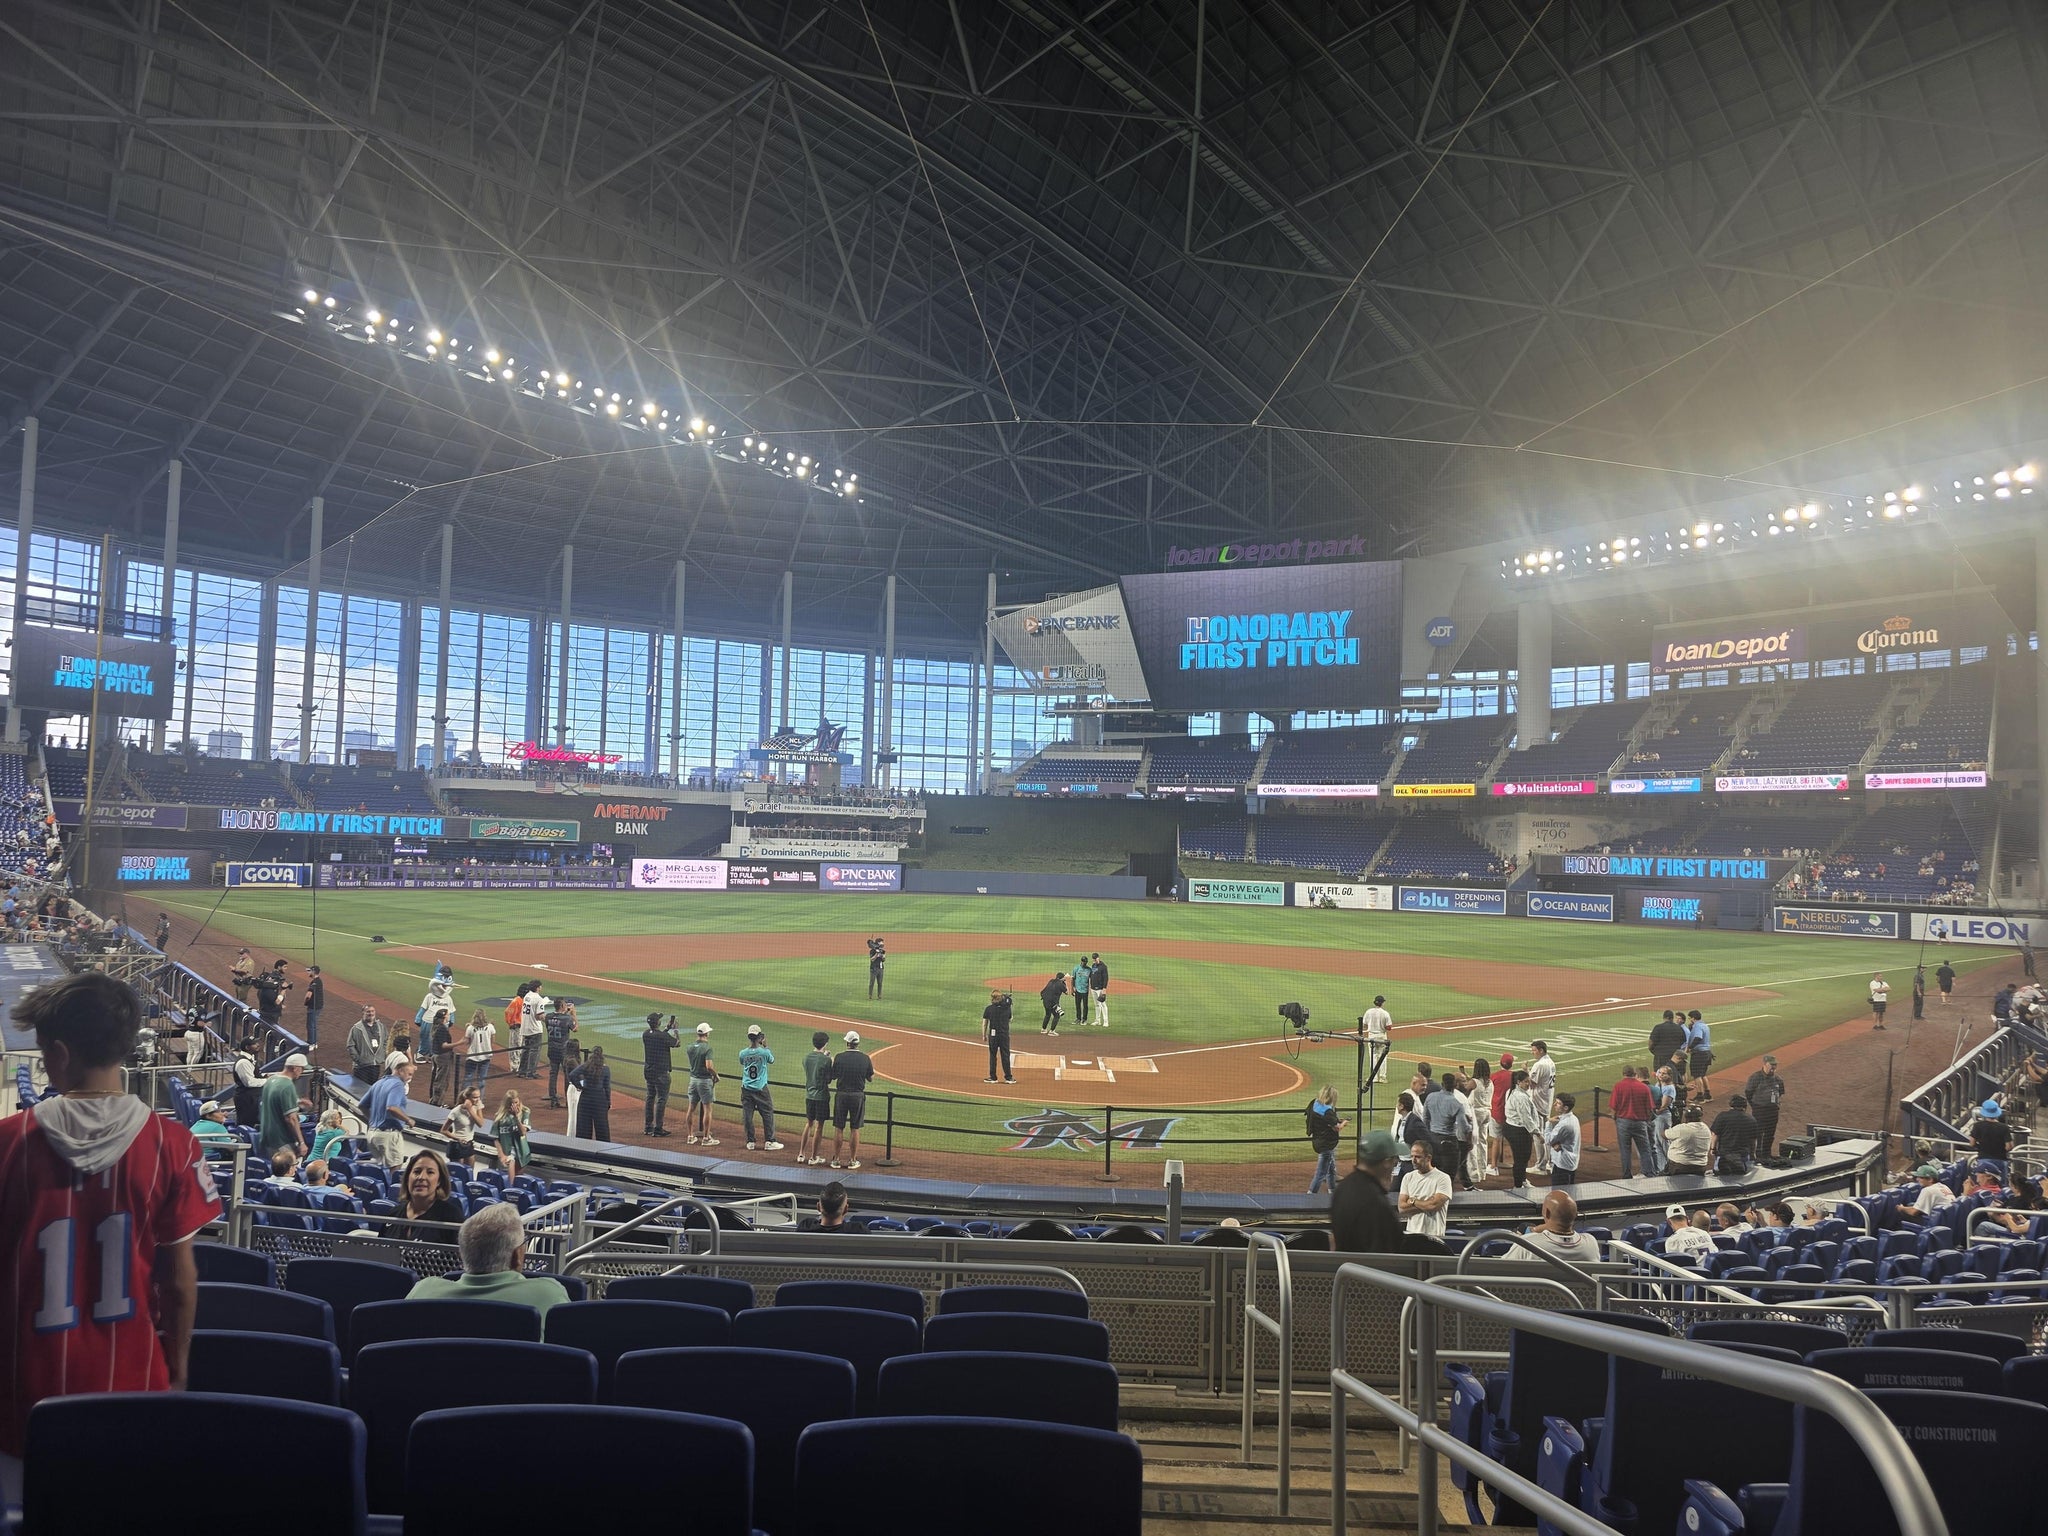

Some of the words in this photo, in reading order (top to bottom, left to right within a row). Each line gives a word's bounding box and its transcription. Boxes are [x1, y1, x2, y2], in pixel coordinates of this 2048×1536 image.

[1305, 535, 1366, 563] park
[1186, 610, 1353, 643] HONORARY
[1429, 625, 1453, 637] ADT
[1665, 631, 1790, 662] loanDepot
[1857, 629, 1938, 654] Corona
[1179, 641, 1262, 670] FIRST
[1267, 637, 1360, 668] PITCH
[61, 656, 151, 680] HONORARY
[105, 676, 154, 696] PITCH
[504, 741, 622, 764] Budweiser
[809, 755, 837, 763] HARBOR
[1016, 783, 1030, 791] PITCH
[1517, 783, 1583, 793] Multinational
[594, 803, 669, 821] AMERANT
[759, 801, 782, 813] arajet
[220, 809, 329, 833] HONORARY
[332, 813, 386, 834] FIRST
[388, 817, 444, 837] PITCH
[615, 822, 649, 836] BANK
[499, 827, 530, 838] Baja
[530, 827, 567, 837] Blast
[1535, 829, 1567, 842] 1796
[121, 856, 189, 869] HONORARY
[1563, 857, 1654, 877] HONORARY
[1656, 858, 1707, 877] FIRST
[1709, 859, 1766, 879] PITCH
[117, 868, 152, 880] FIRST
[154, 869, 190, 880] PITCH
[244, 867, 295, 882] GOYA
[1212, 884, 1279, 893] NORWEGIAN
[1342, 887, 1354, 896] GO.
[1419, 892, 1448, 907] blu
[1454, 893, 1501, 901] DEFENDING
[1643, 897, 1700, 909] HONORARY
[1454, 901, 1479, 909] HOME
[1544, 900, 1578, 911] OCEAN
[1580, 903, 1609, 913] BANK
[1641, 907, 1670, 919] FIRST
[1800, 912, 1847, 924] NEREUS
[1952, 920, 2029, 941] LEON
[749, 1066, 758, 1080] 8
[34, 1211, 134, 1334] 11
[1863, 1373, 1897, 1385] ARTIFEX
[1899, 1374, 1964, 1387] CONSTRUCTION
[1914, 1426, 1997, 1444] CONSTRUCTION
